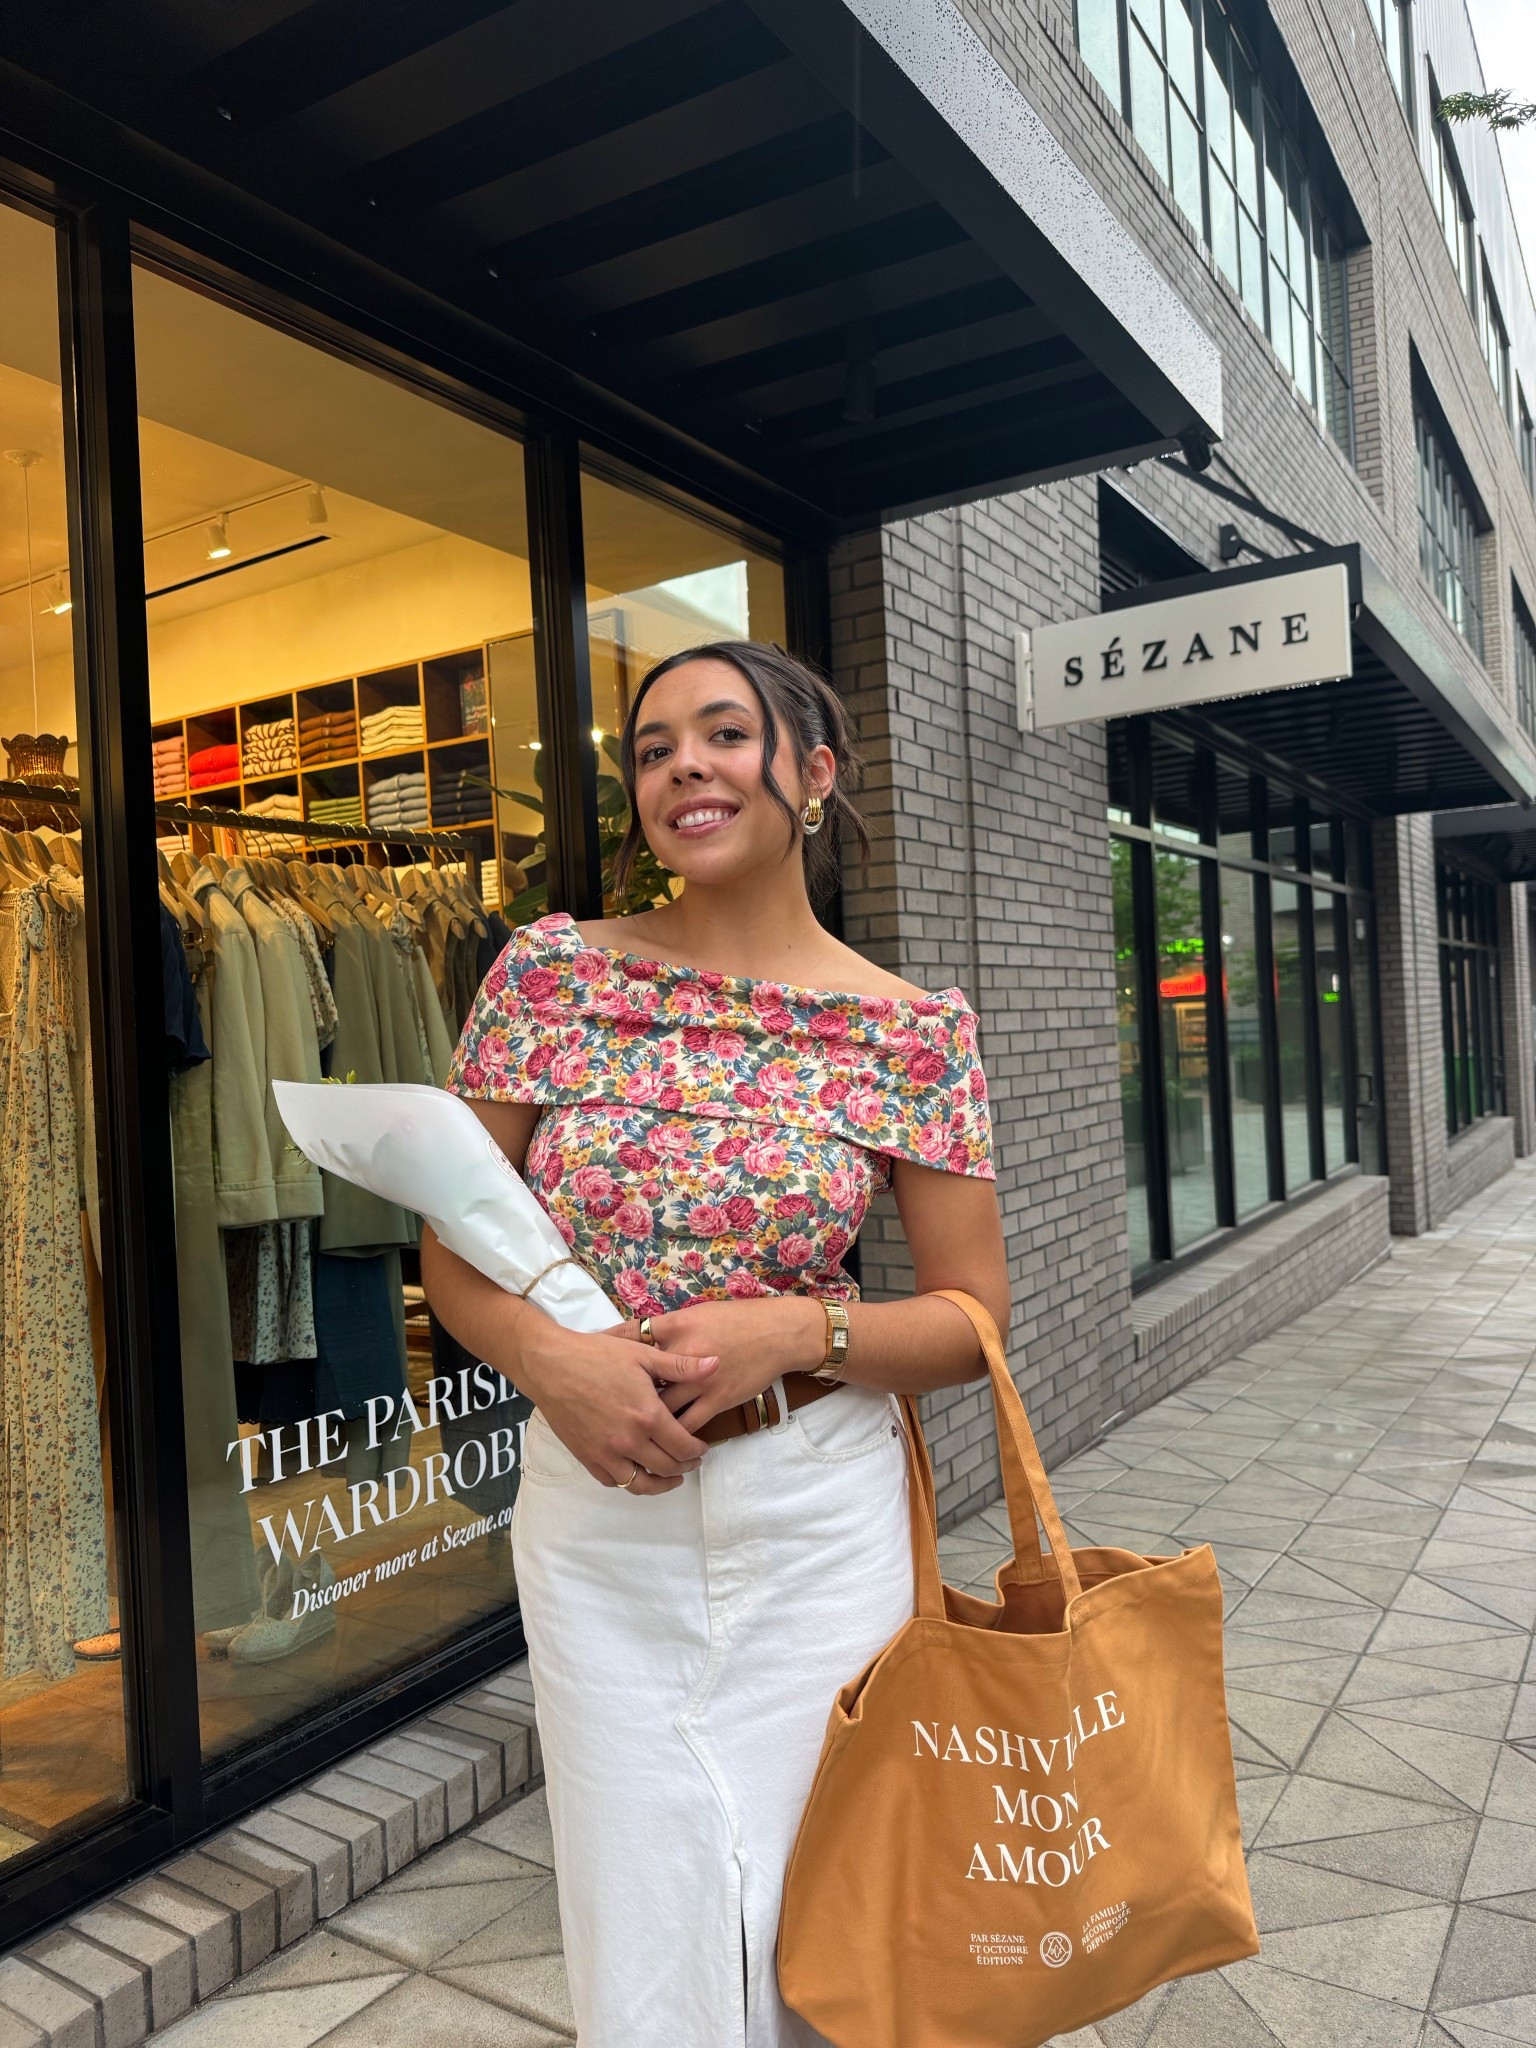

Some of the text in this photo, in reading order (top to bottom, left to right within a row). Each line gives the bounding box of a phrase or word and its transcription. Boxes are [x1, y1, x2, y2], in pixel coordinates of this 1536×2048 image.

[1064, 613, 1310, 688] SÉZANE
[226, 1362, 520, 1494] THE PARISI
[290, 1506, 515, 1621] Discover more at Sezane.co
[911, 1690, 1126, 1777] NASHVILE
[964, 1817, 1112, 1888] AMOUR
[1090, 1901, 1127, 1924] FAMILLE
[969, 1944, 1029, 1954] ET OCTOBRE
[970, 1933, 1026, 1944] PAR SÉZANE
[976, 1955, 1024, 1965] ÉDITIONS
[1086, 1930, 1114, 1954] DEPUIS
